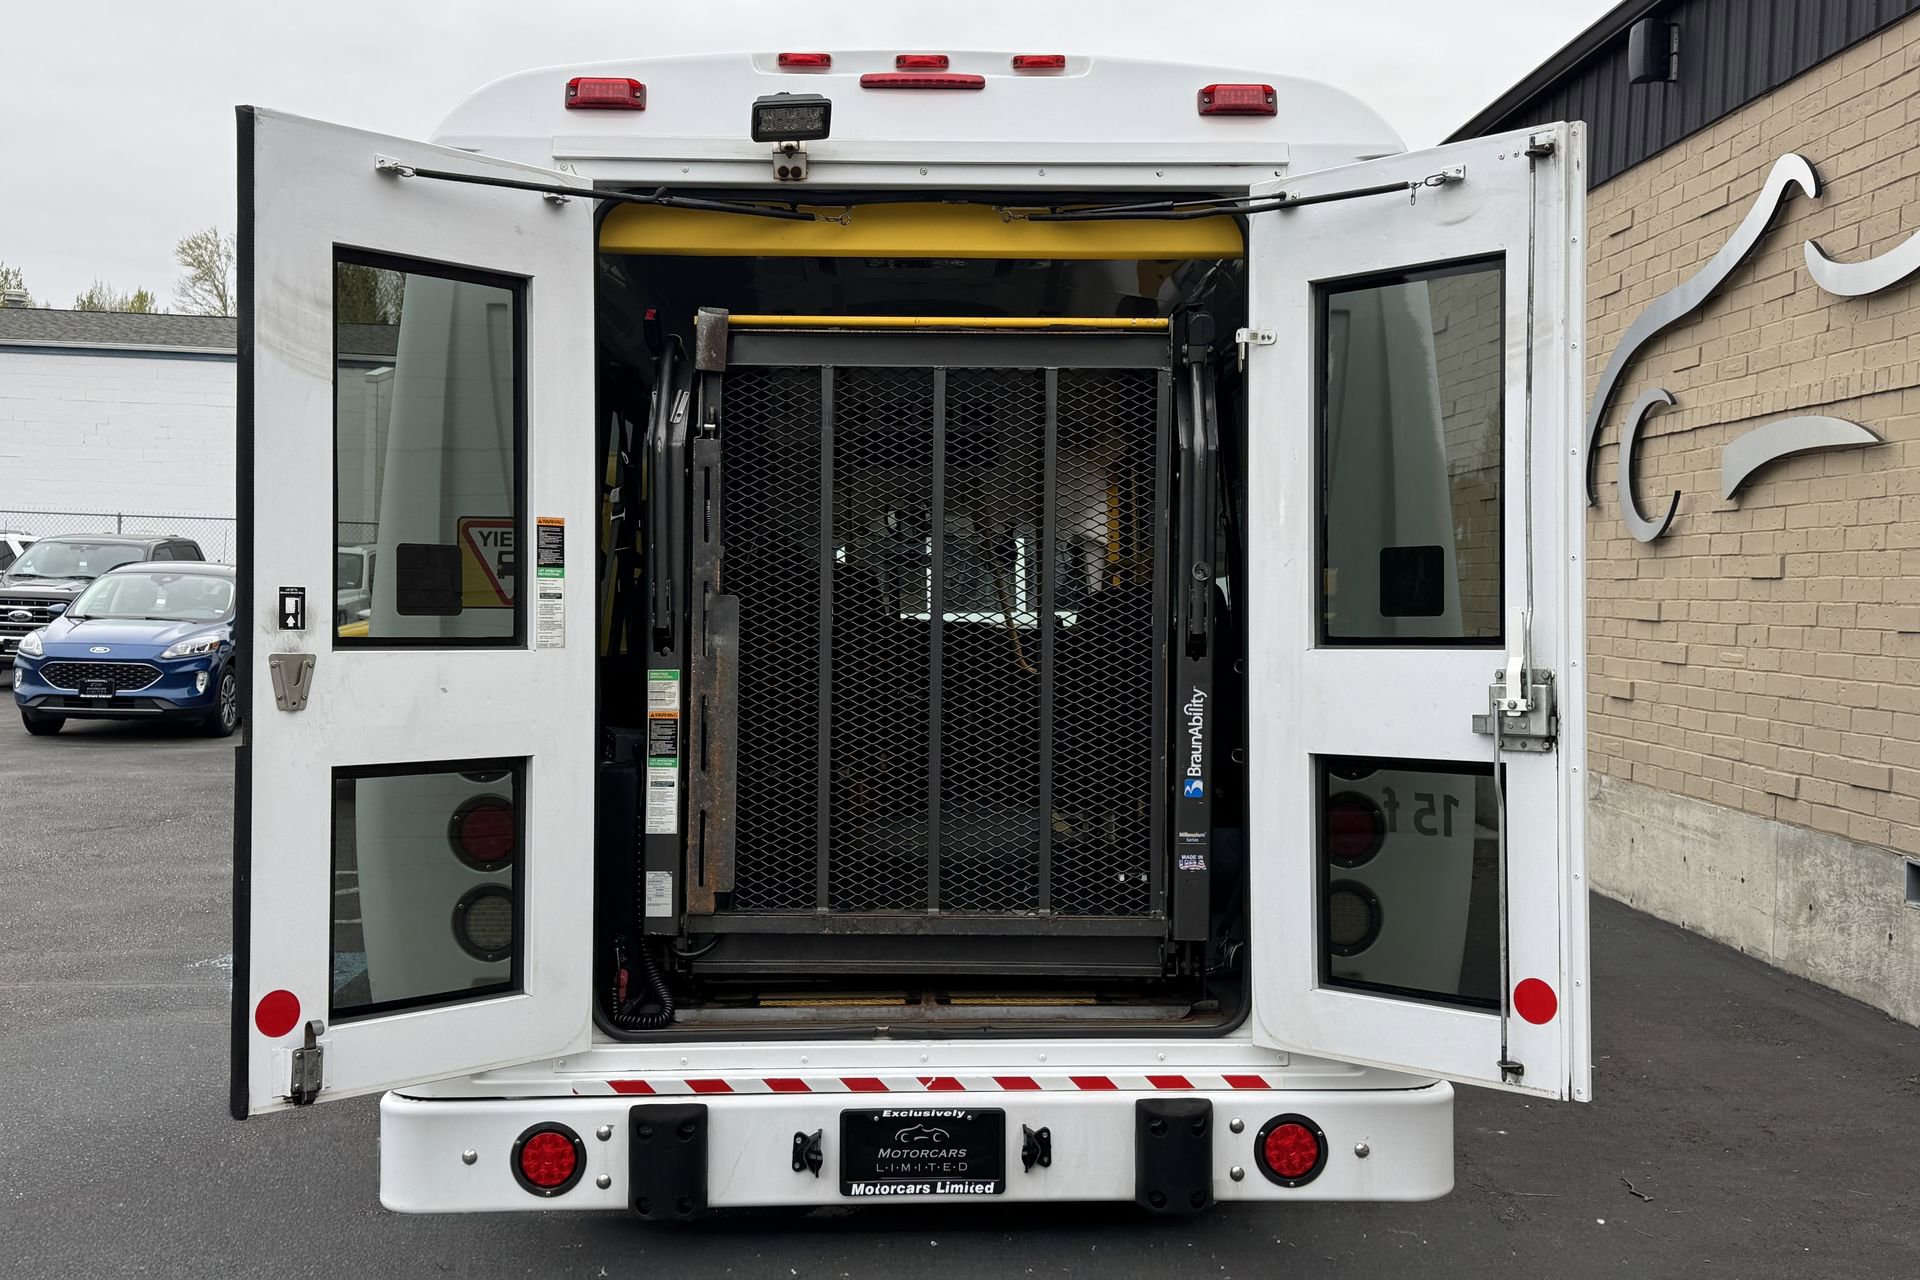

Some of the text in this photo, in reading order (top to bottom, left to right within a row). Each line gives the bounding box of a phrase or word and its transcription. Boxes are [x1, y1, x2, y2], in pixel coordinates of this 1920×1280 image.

[478, 531, 512, 547] YIE
[1184, 688, 1207, 776] BraunAbility
[882, 1109, 966, 1119] Exclusively
[878, 1148, 967, 1159] MOTORCARS
[851, 1181, 995, 1196] Motorcars Limited
